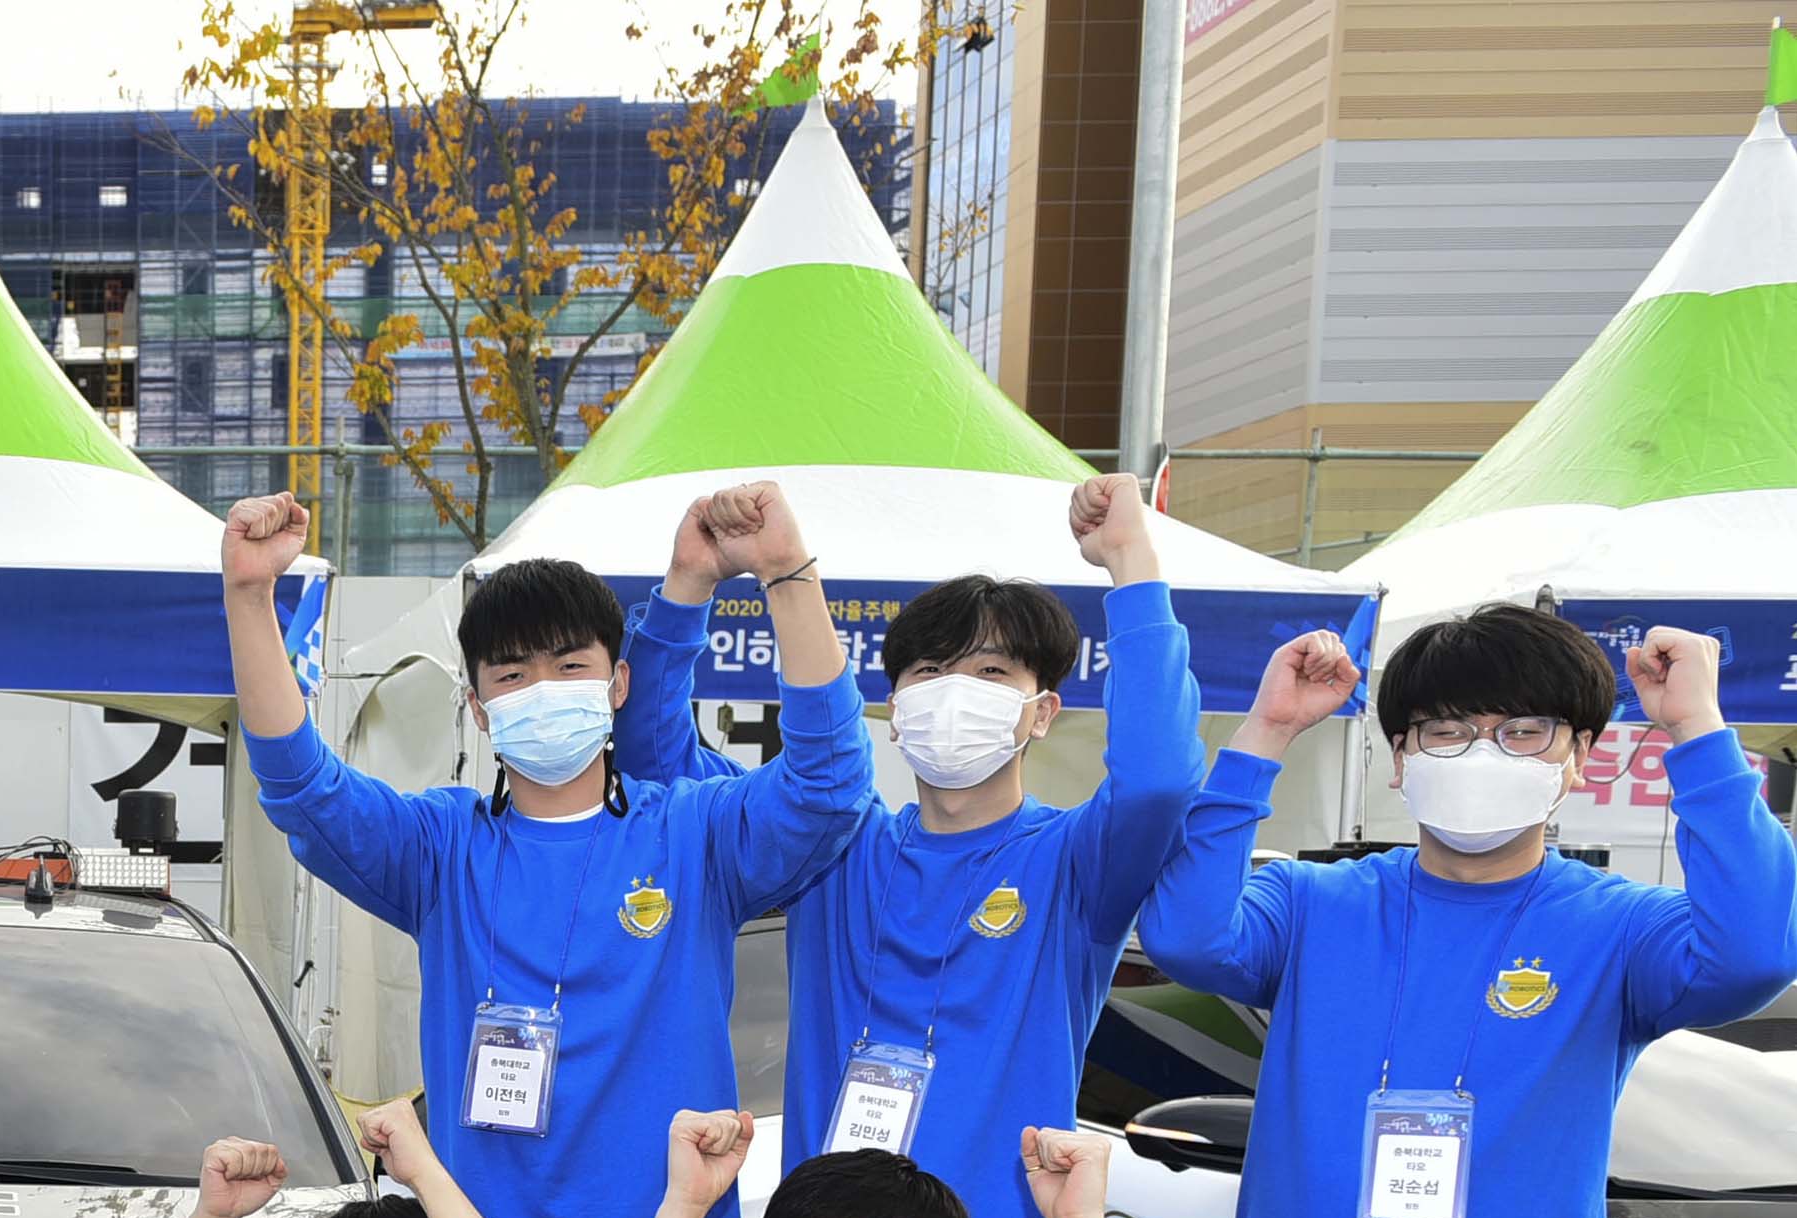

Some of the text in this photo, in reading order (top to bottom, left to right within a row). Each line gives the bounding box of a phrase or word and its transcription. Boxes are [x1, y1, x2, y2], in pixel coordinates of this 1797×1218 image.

[715, 599, 763, 617] 2020
[849, 1122, 890, 1143] 김민성
[1394, 1147, 1443, 1157] 충북대학교
[1406, 1162, 1426, 1171] 타요
[1389, 1179, 1439, 1195] 권순섭
